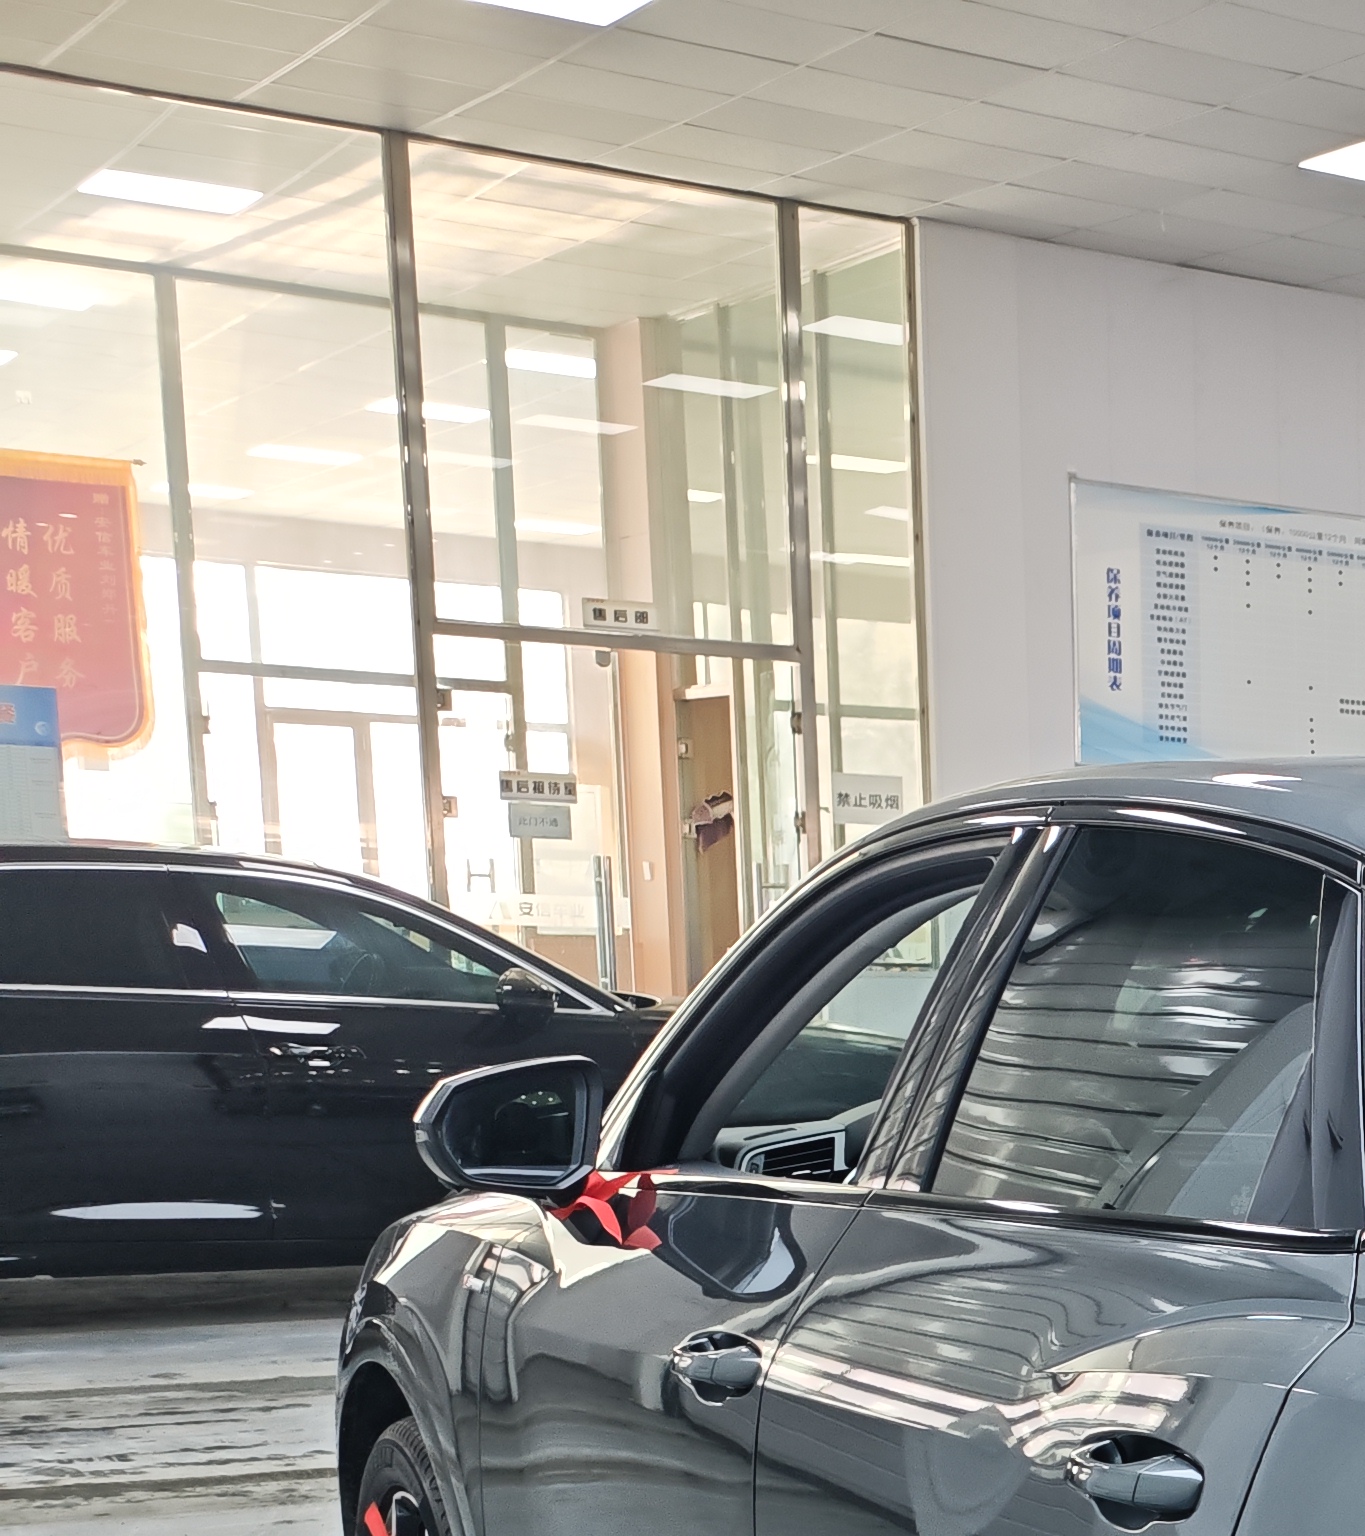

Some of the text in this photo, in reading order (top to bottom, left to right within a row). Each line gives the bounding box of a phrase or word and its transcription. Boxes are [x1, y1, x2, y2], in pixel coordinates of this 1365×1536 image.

[1, 517, 39, 685] 情暖客户
[43, 522, 85, 688] 优质服务
[836, 791, 900, 810] 禁止吸烟
